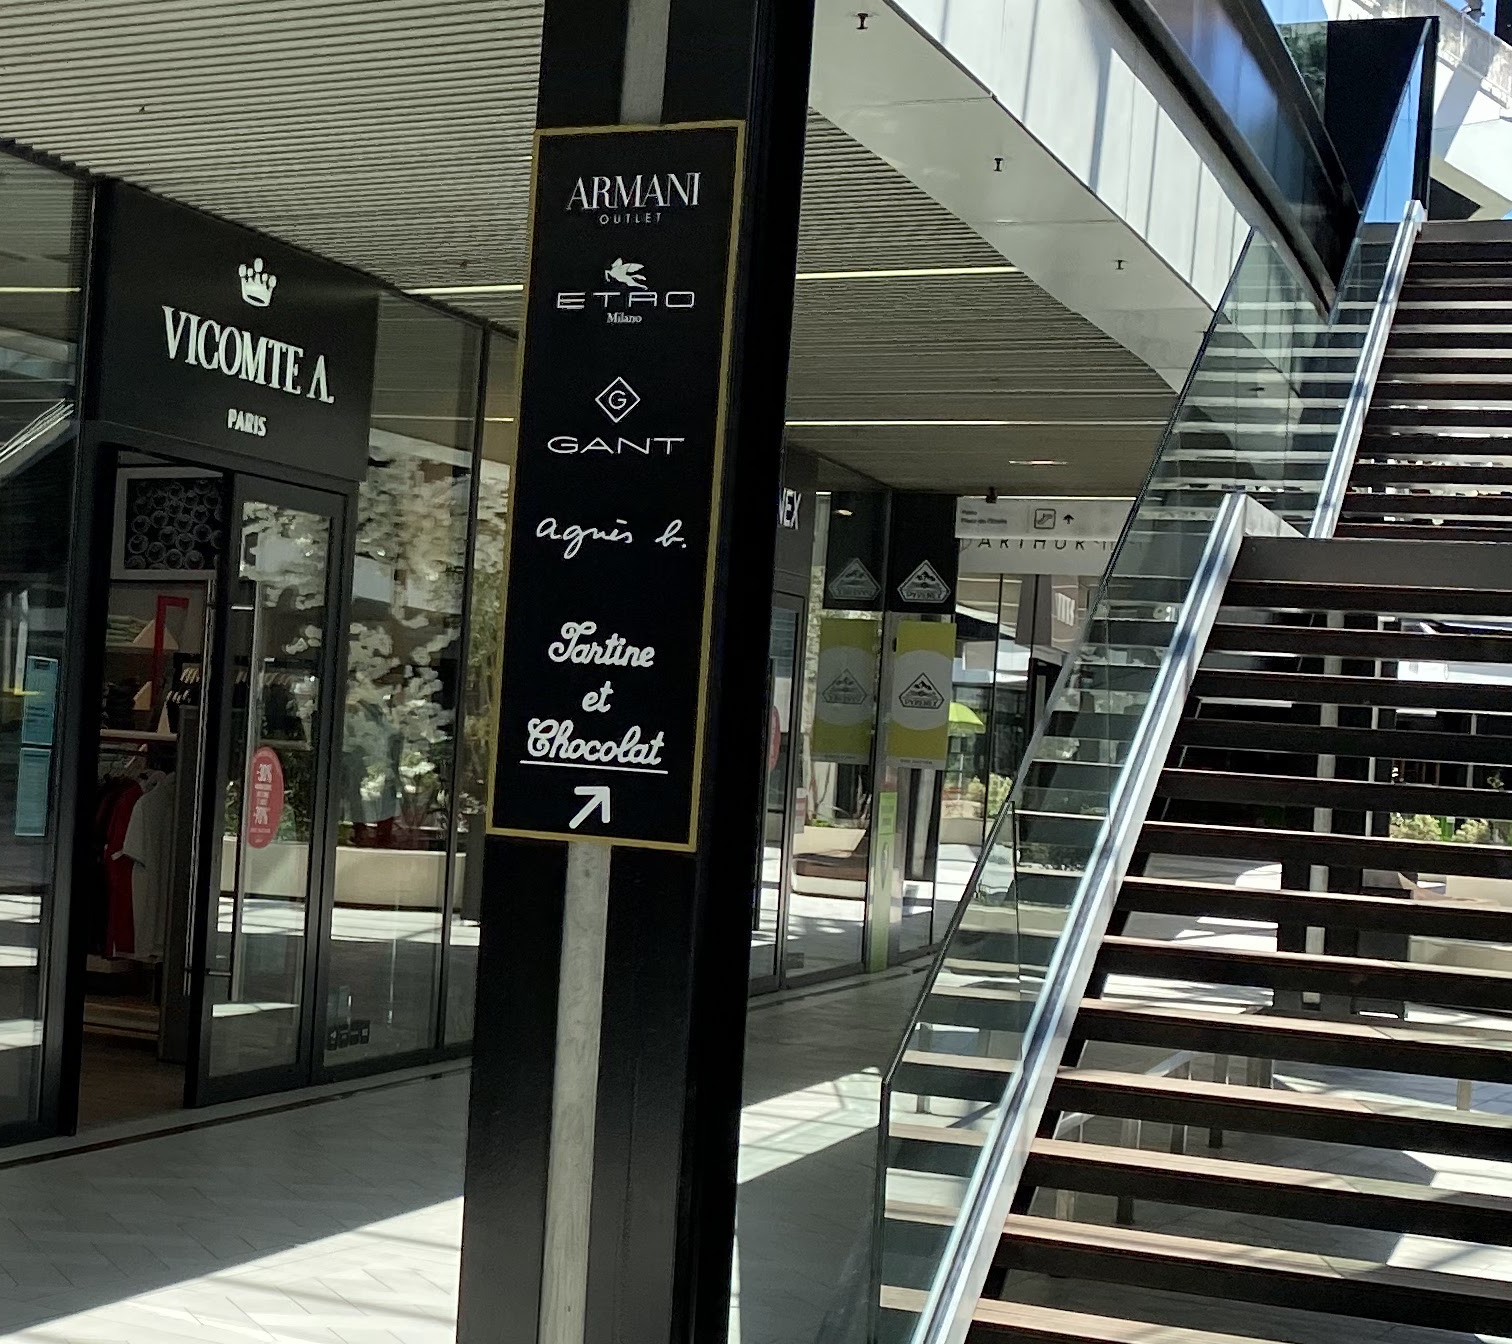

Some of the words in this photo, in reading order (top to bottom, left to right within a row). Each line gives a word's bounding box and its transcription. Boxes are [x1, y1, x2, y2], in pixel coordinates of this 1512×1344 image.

[566, 172, 701, 211] ARMANI
[599, 212, 662, 225] OUTLET
[606, 311, 642, 325] Milano
[161, 305, 304, 395] VICOMTE
[227, 408, 267, 437] PARIS
[547, 436, 685, 455] GANT
[536, 517, 634, 560] agnès
[654, 519, 687, 549] b.
[548, 621, 656, 668] Tartine
[582, 680, 614, 713] et
[527, 717, 665, 766] Chocolat
